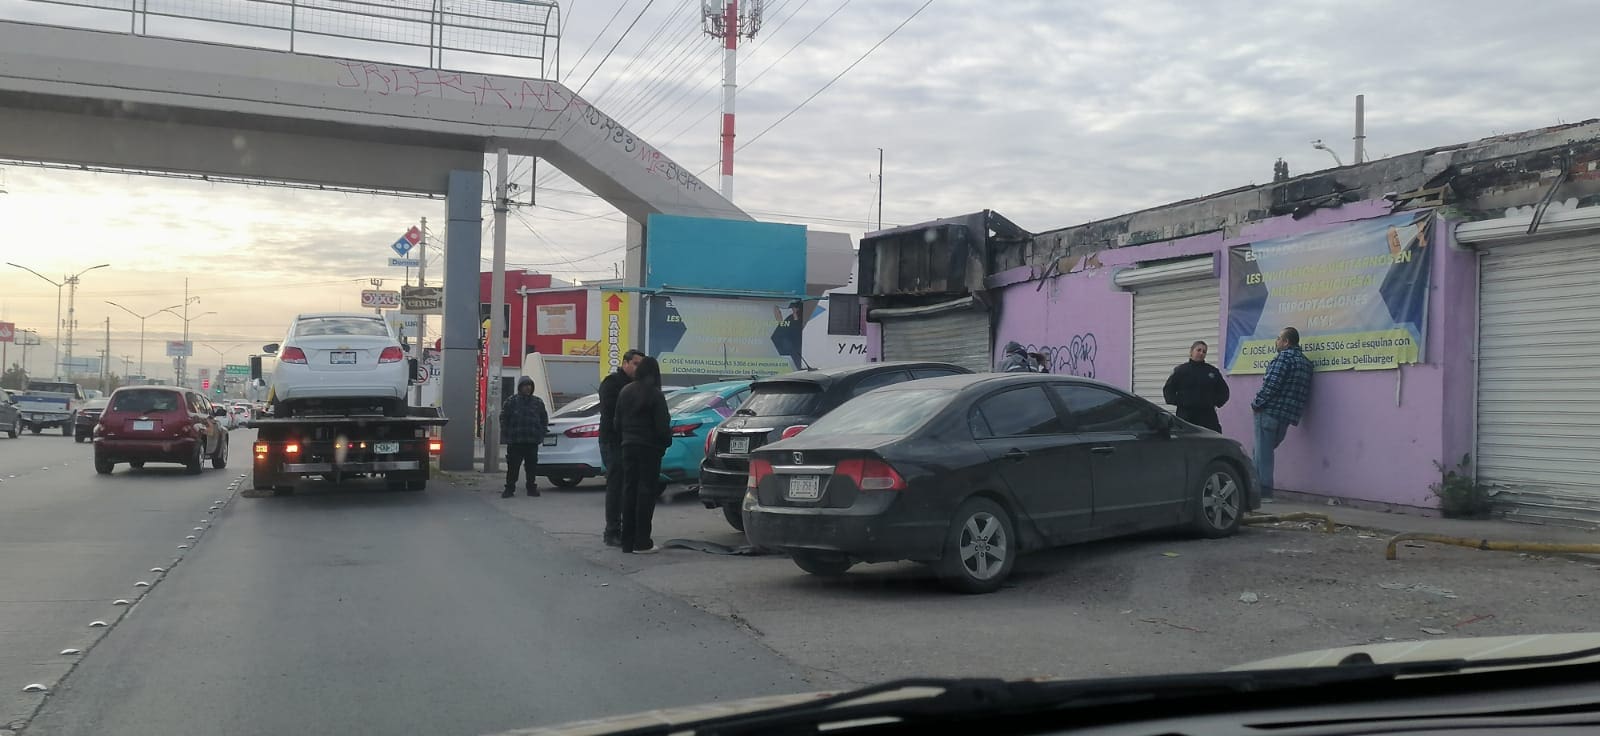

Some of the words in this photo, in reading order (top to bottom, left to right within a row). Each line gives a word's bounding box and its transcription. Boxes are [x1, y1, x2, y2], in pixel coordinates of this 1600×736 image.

[1246, 273, 1261, 285] LES
[1395, 249, 1411, 263] EN
[1278, 295, 1368, 312] IMPORTACIONES
[838, 343, 846, 354] Y
[1300, 342, 1325, 353] LESIAS
[1326, 341, 1345, 351] 5306
[1345, 339, 1361, 350] casi
[1361, 337, 1393, 350] esquina
[1394, 337, 1411, 346] con
[1331, 356, 1340, 365] de
[1341, 355, 1351, 365] las
[1352, 354, 1395, 365] Deliburger
